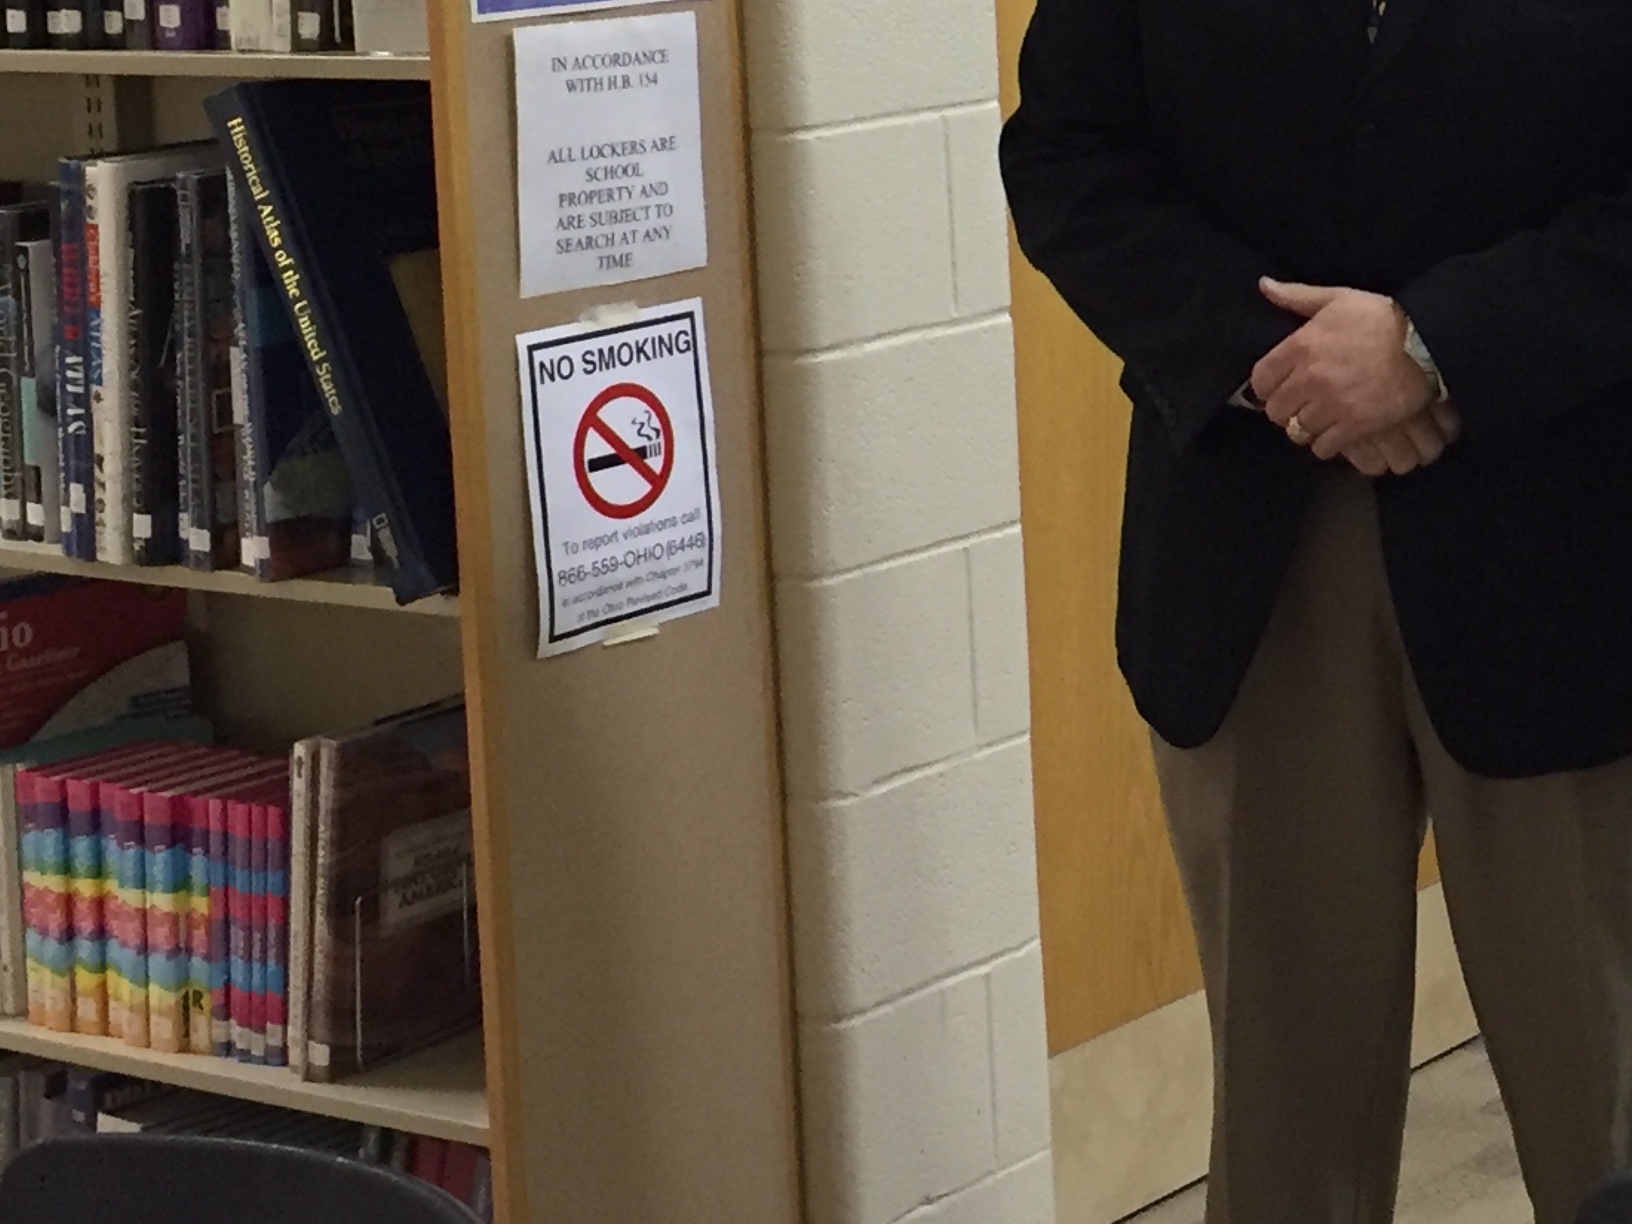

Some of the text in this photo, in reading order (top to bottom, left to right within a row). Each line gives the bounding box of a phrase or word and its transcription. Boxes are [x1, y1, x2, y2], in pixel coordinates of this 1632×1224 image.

[551, 48, 670, 73] IN ACCORDANCE
[565, 76, 605, 94] WITH
[226, 116, 271, 201] Historical
[547, 135, 678, 164] ALL LOCKERS ARE
[585, 161, 644, 183] SCHOOL
[558, 181, 669, 209] PROPERTY AND
[257, 203, 282, 250] Atlas
[555, 202, 674, 231] ARE SUBJECT TO
[555, 225, 673, 255] SEARCH AT ANY
[274, 249, 294, 268] of
[597, 252, 633, 270] TIME
[281, 268, 301, 300] the
[293, 300, 327, 363] United
[538, 328, 692, 386] NO SMOKING
[315, 361, 344, 417] States
[561, 507, 702, 556] To report violations call
